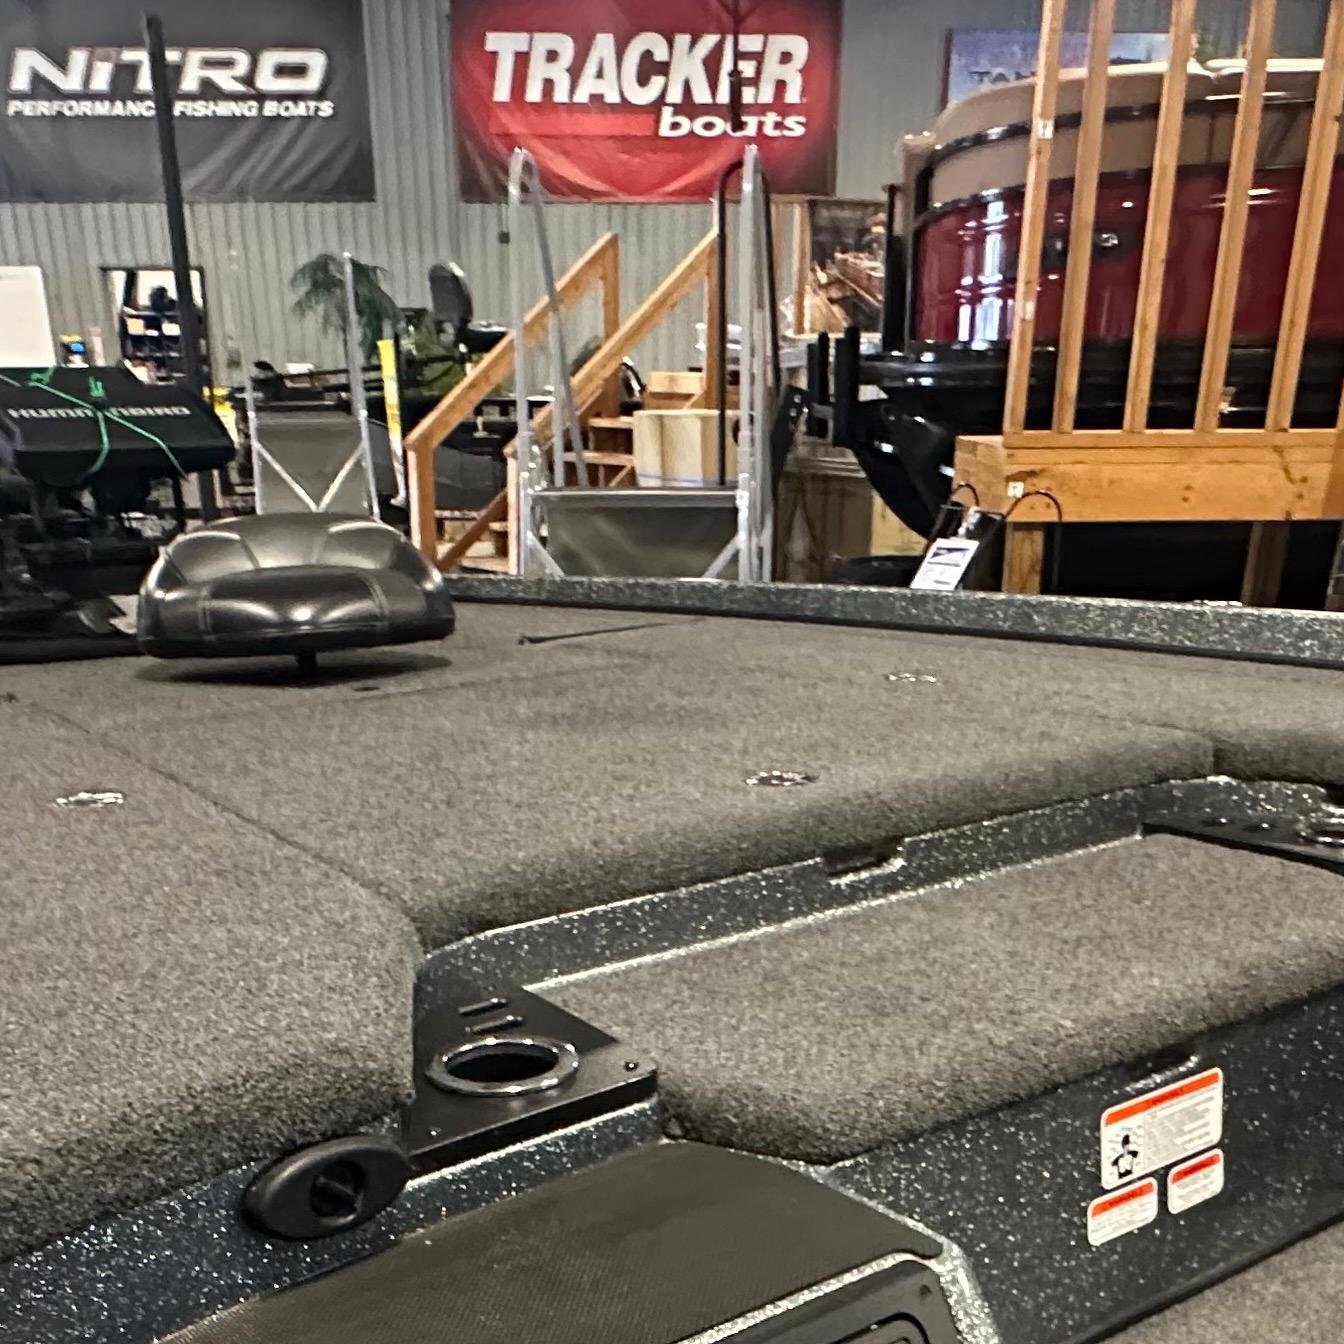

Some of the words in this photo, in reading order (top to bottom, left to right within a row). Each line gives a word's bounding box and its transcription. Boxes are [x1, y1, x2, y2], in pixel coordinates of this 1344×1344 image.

[485, 31, 808, 105] TRACKER
[6, 100, 156, 118] PERFORMANC
[172, 101, 258, 118] FISHING
[262, 101, 334, 118] BOATS
[658, 106, 806, 137] boats
[7, 405, 192, 419] HUMMNBIRD
